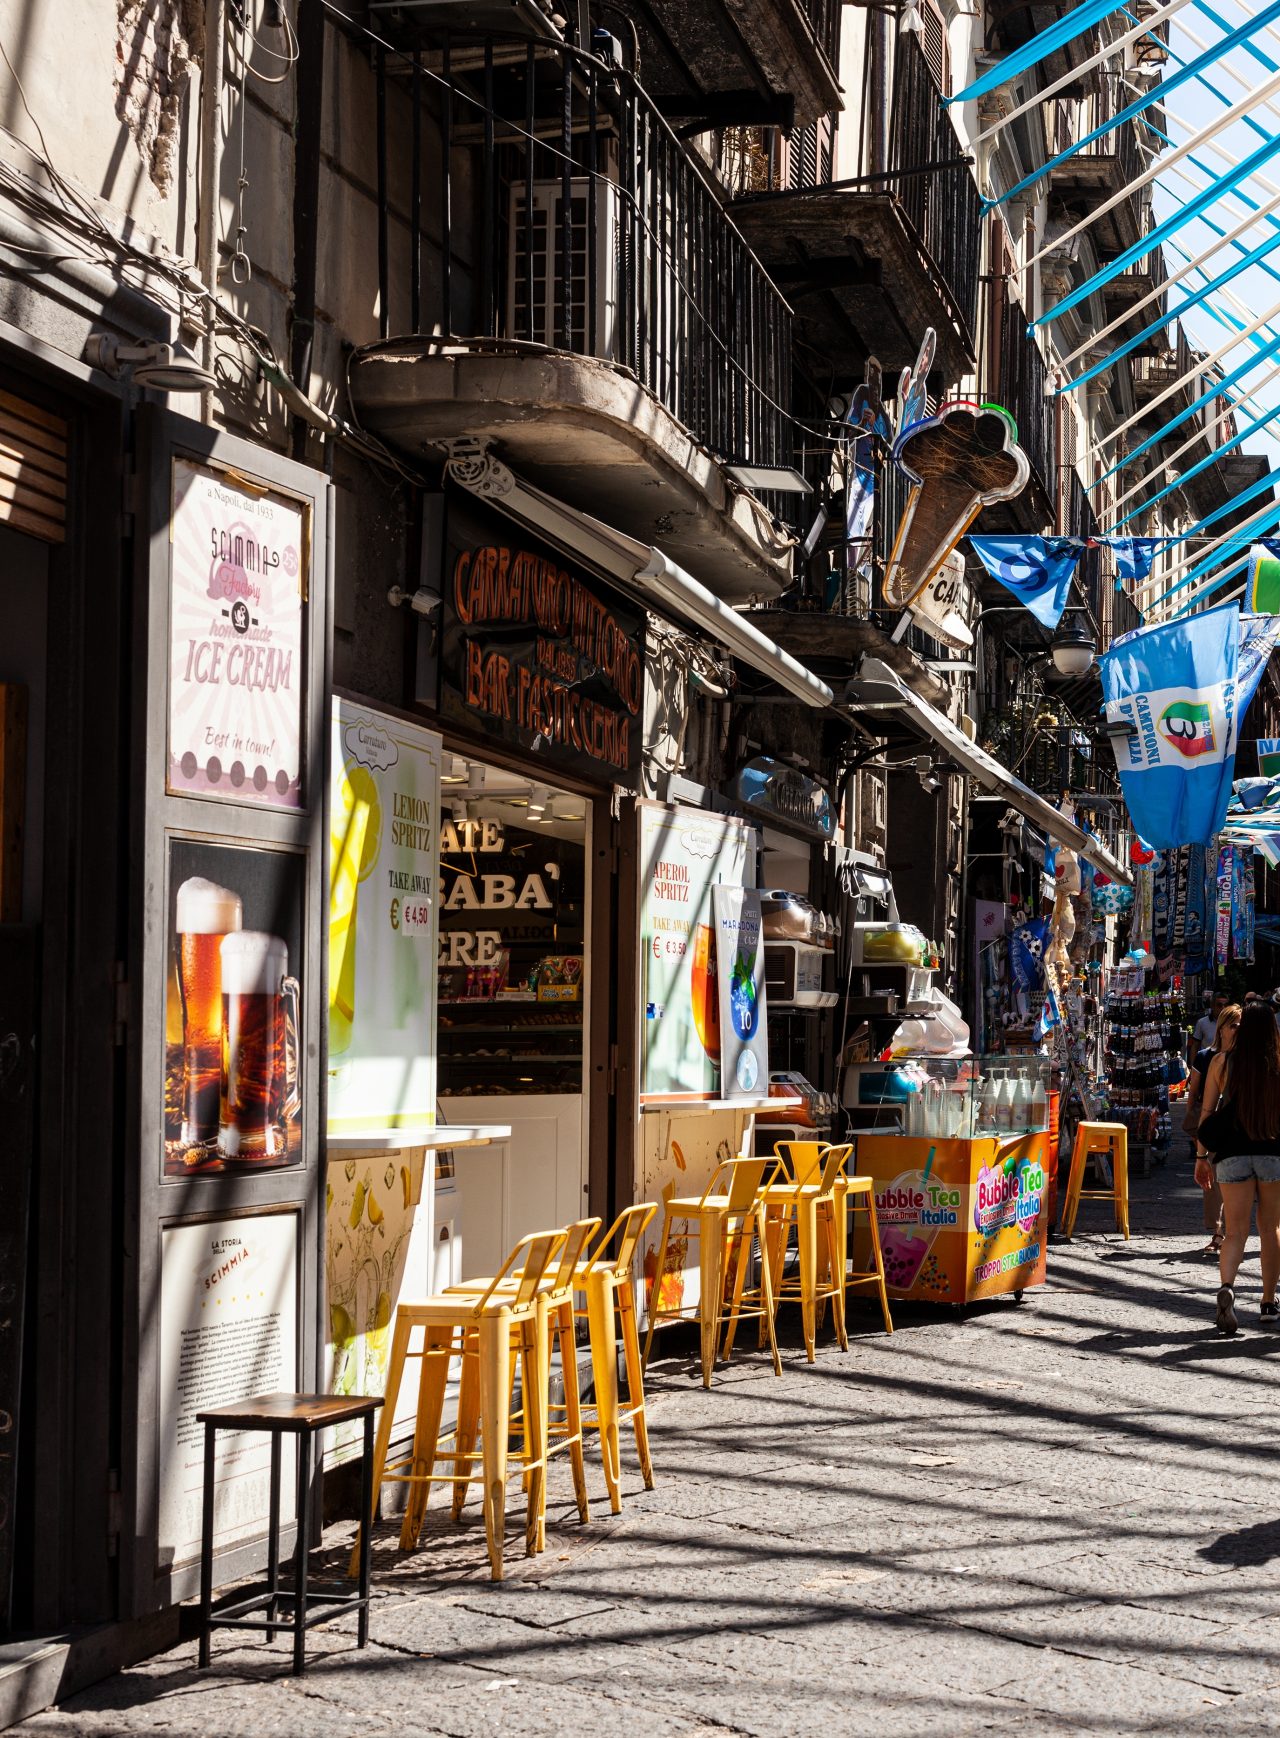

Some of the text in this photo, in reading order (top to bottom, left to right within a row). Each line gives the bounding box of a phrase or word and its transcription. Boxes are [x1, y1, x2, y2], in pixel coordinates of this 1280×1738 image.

[211, 527, 280, 576] SCIMMIA
[184, 639, 293, 694] ICE CREAM
[392, 791, 431, 826] LEMON
[391, 820, 431, 853] SPRITZ
[388, 869, 432, 896] TAKE AWAY
[652, 860, 691, 884] APEROL
[1221, 856, 1233, 902] NAPOLI
[653, 880, 690, 903] SPRITZ
[412, 906, 428, 928] 4,50
[722, 918, 760, 932] MARADONA
[740, 1010, 752, 1031] 10
[865, 1185, 961, 1211] ubble Tea
[978, 1164, 1044, 1211] Bubble Tea
[873, 1210, 899, 1221] plosive
[921, 1208, 958, 1226] Italia
[1016, 1195, 1041, 1221] Italia
[204, 1247, 249, 1290] SCIMMIA
[974, 1258, 1002, 1284] TROPPO
